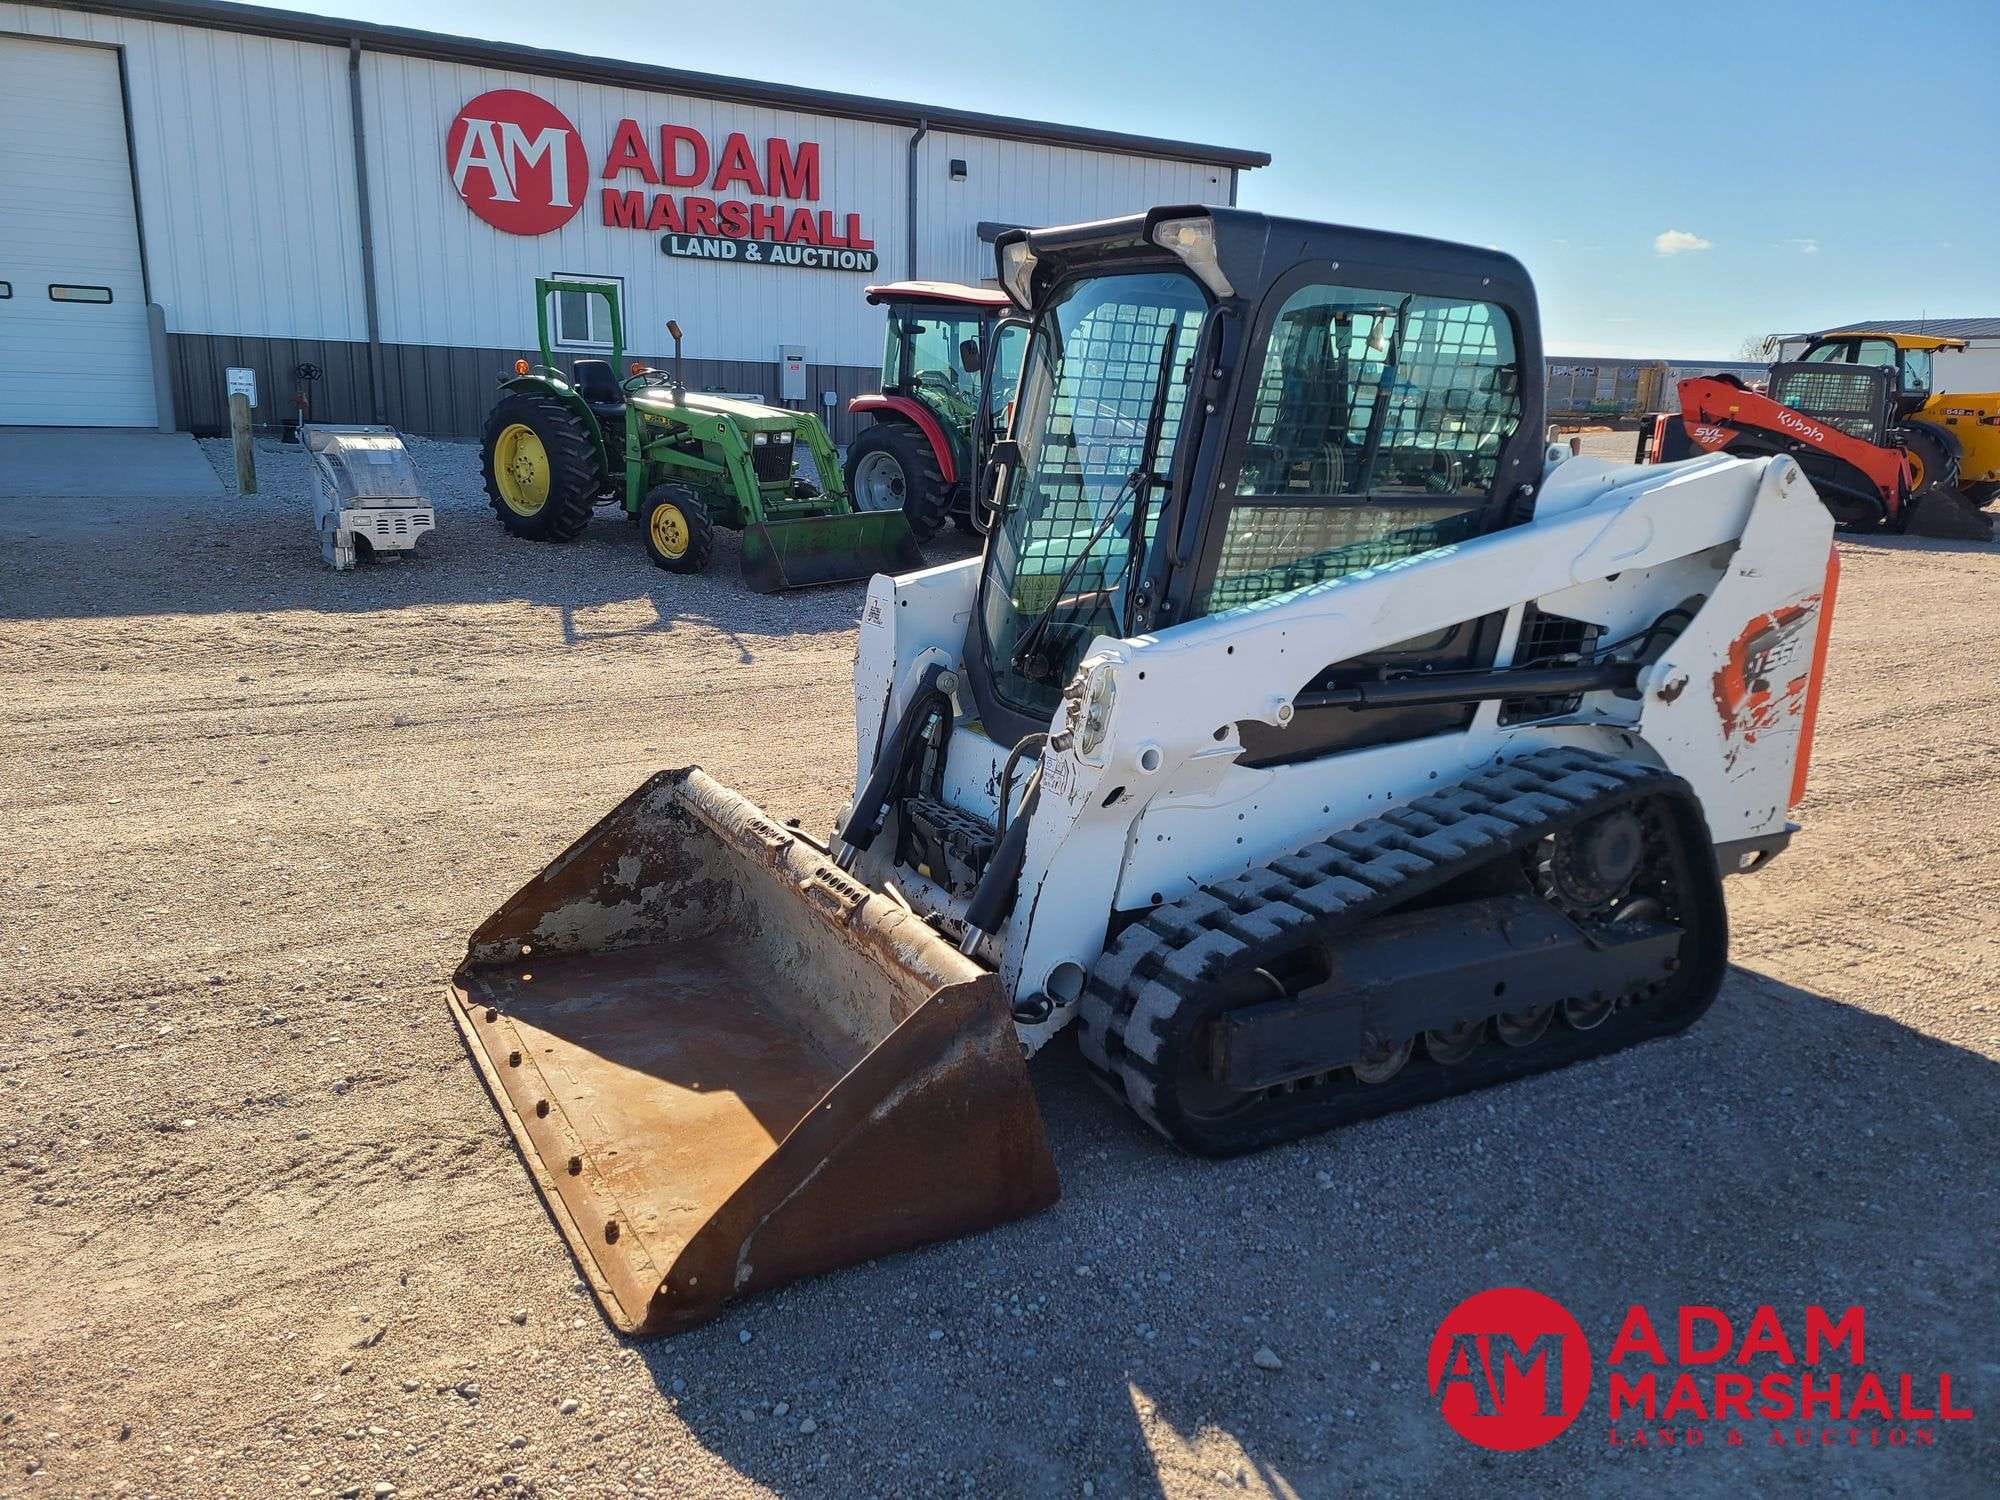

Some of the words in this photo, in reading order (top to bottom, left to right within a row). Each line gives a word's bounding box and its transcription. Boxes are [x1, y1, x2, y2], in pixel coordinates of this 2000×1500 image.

[451, 117, 571, 208] AM
[602, 118, 820, 201] ADAM
[601, 187, 875, 250] MARSHALL
[671, 236, 736, 260] LAND
[746, 242, 762, 261] &
[770, 244, 873, 271] AUCTION
[1694, 427, 1724, 438] SVL
[1777, 411, 1824, 442] Kubota
